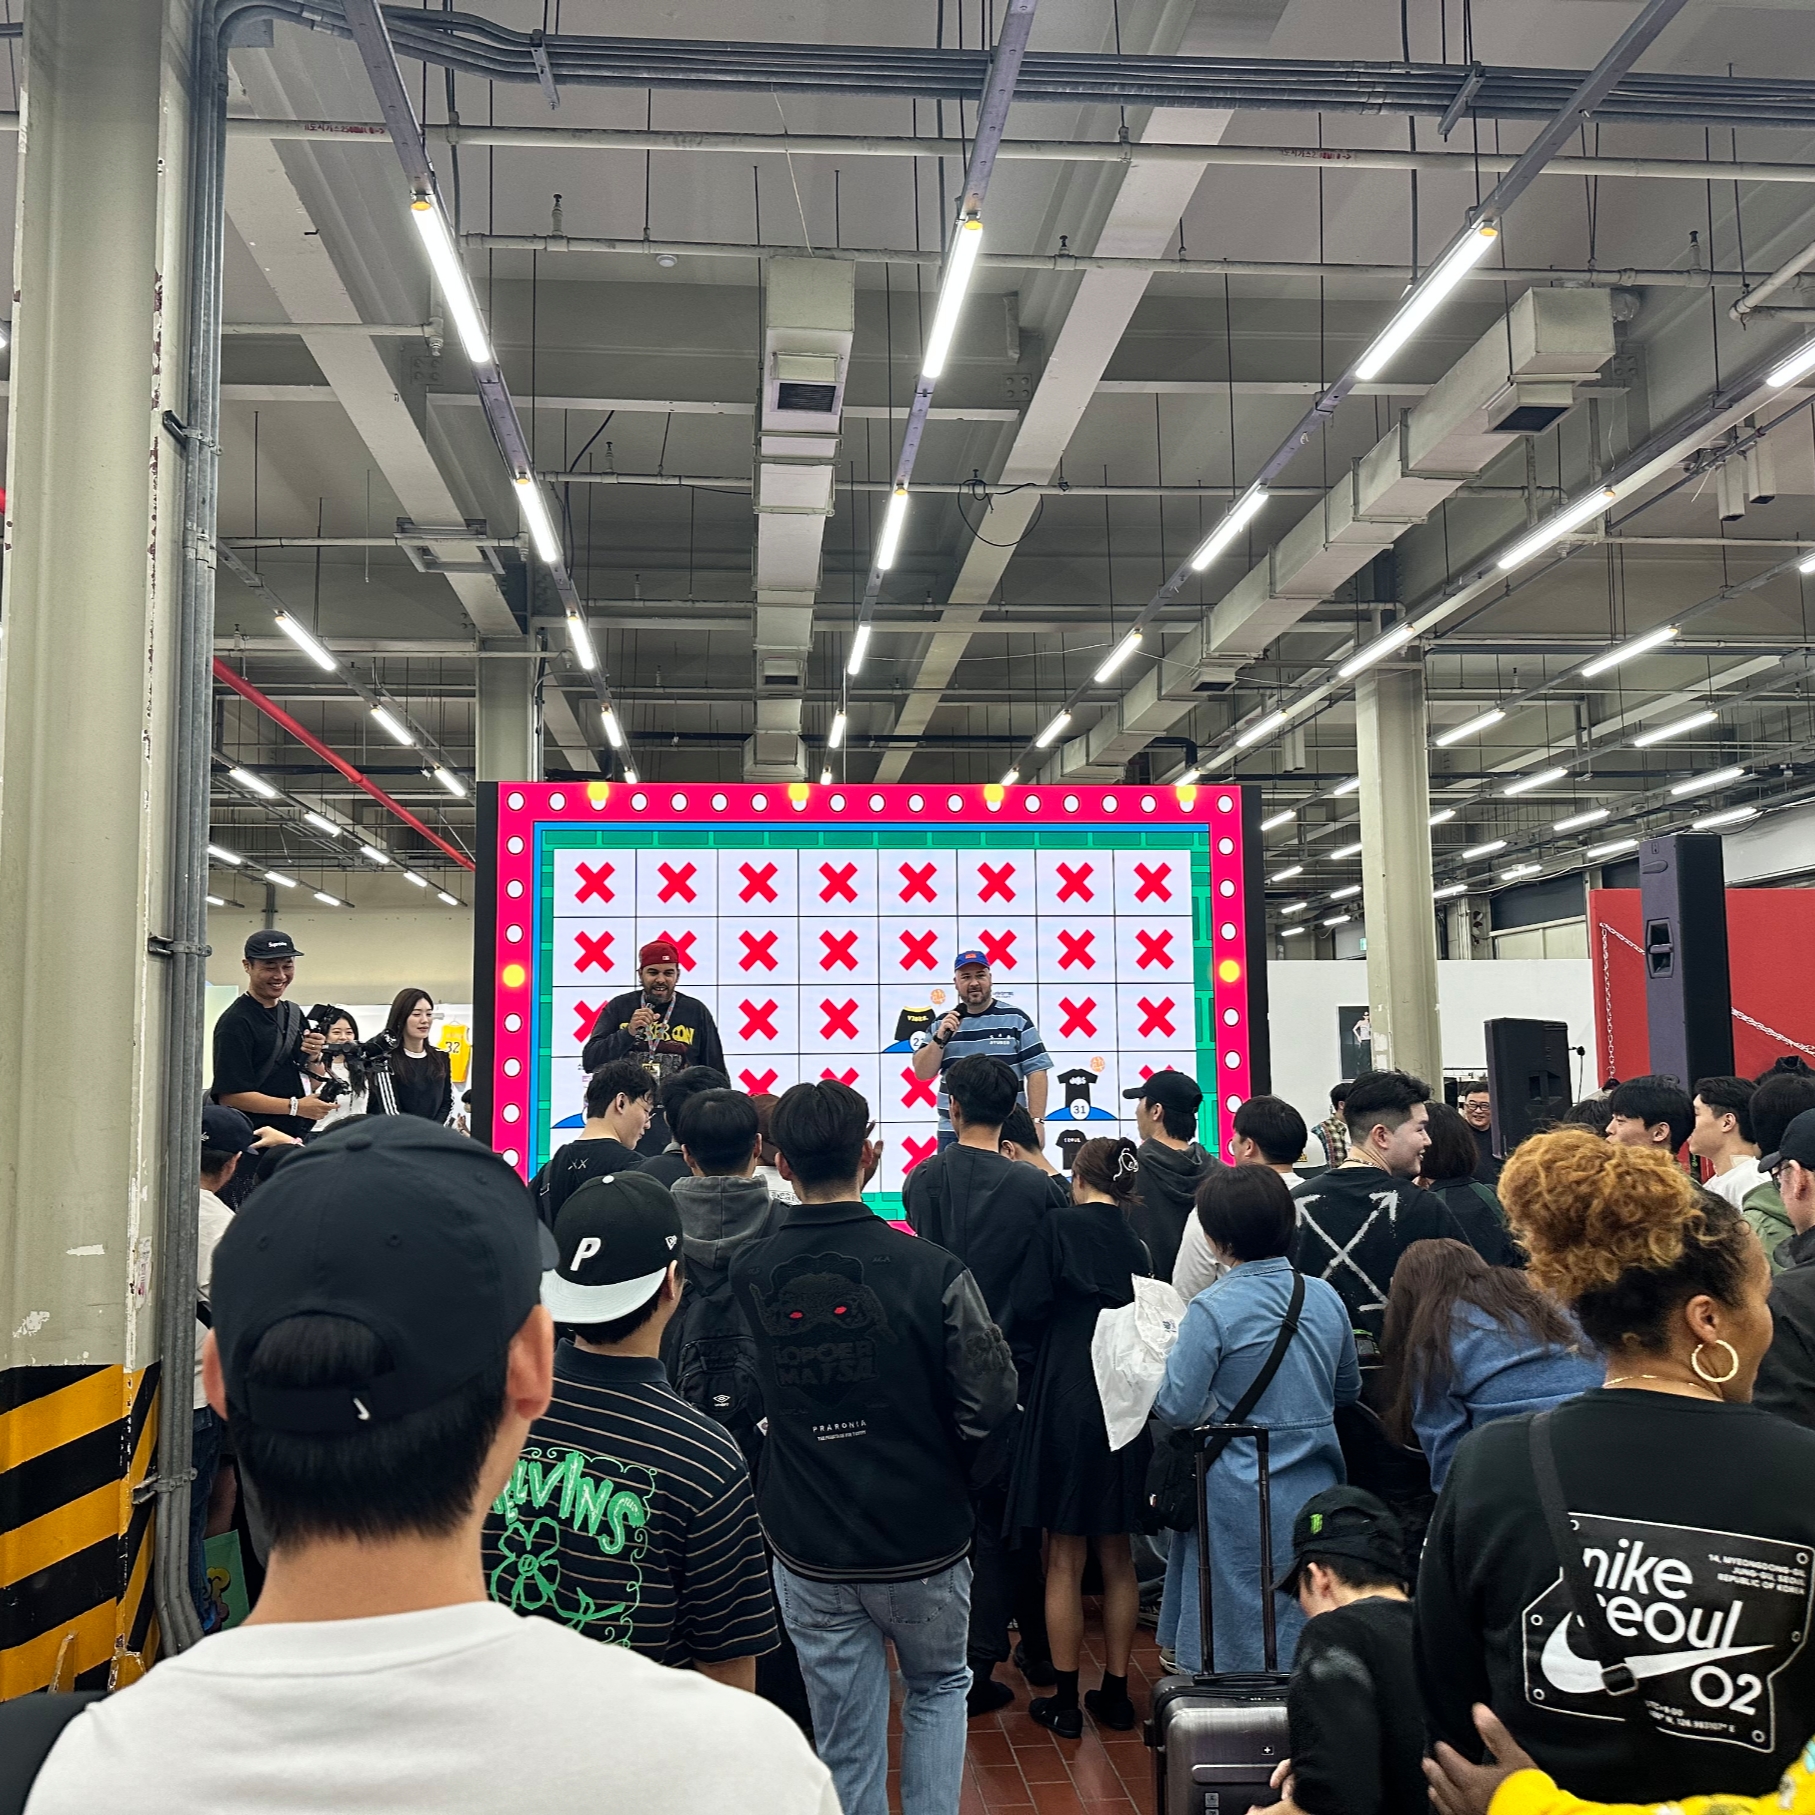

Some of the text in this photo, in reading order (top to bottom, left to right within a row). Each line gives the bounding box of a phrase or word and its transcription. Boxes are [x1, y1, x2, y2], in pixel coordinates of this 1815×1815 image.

[445, 1041, 460, 1053] 32
[1073, 1105, 1086, 1114] 31
[570, 1237, 602, 1272] P
[1577, 1594, 1744, 1650] eoul
